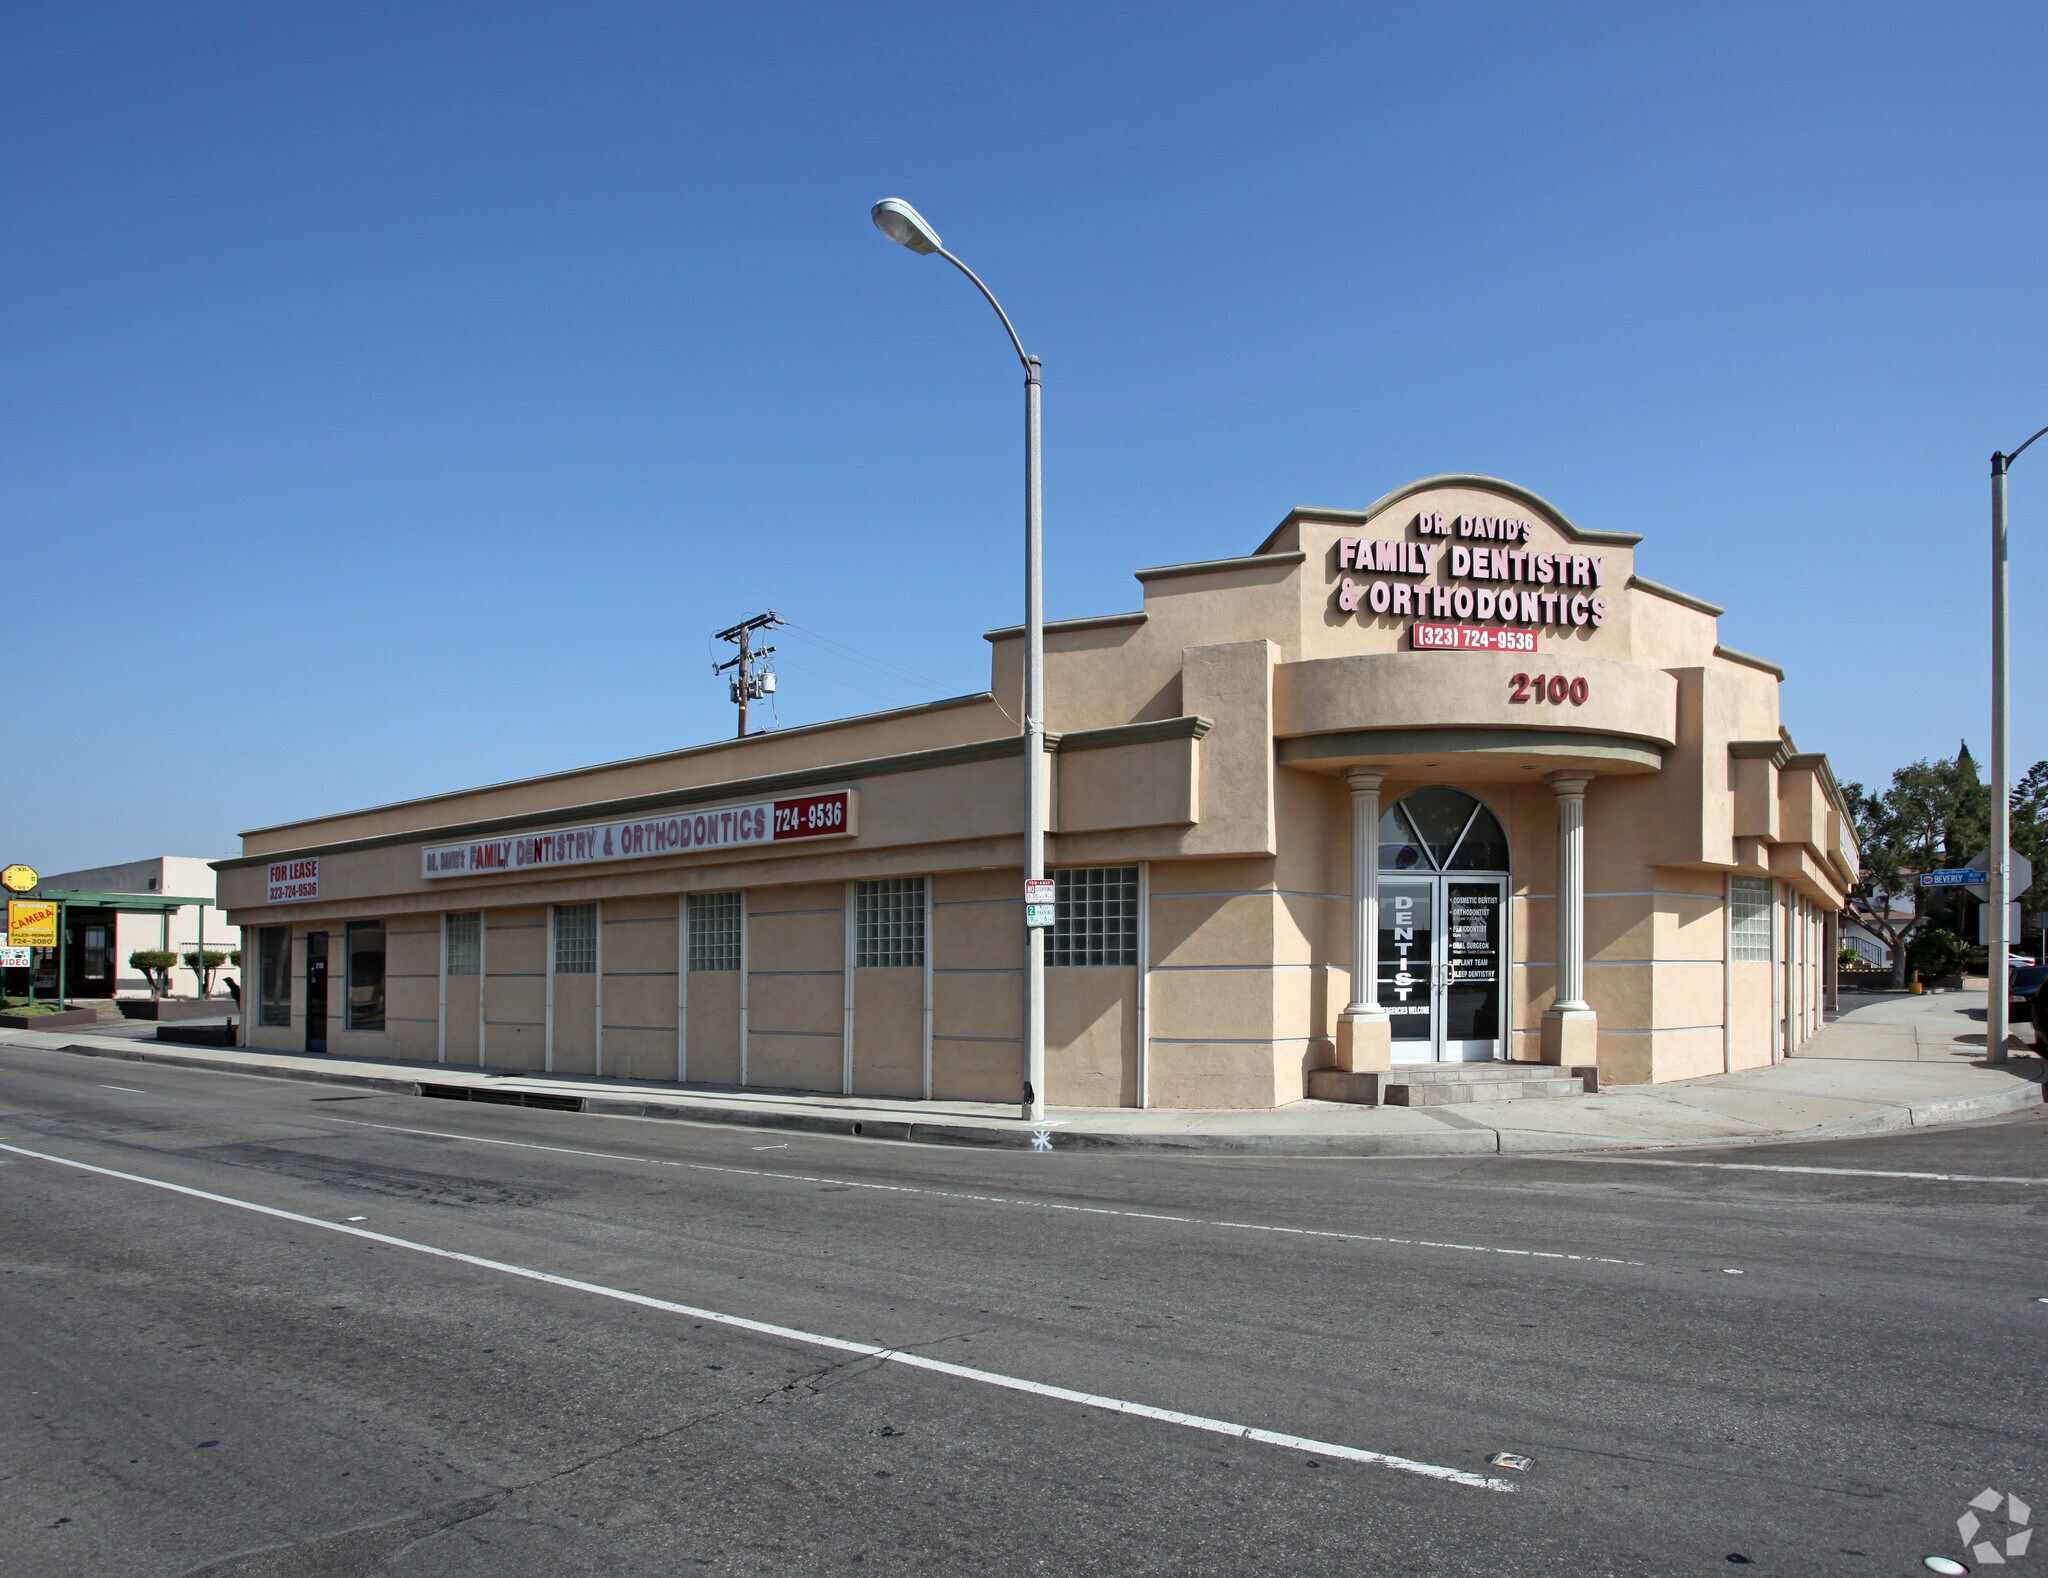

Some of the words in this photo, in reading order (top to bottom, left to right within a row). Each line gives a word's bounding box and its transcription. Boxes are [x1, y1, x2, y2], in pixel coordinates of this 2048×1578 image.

[1418, 511, 1451, 535] DR.
[1459, 514, 1534, 543] DAVID'S
[1338, 537, 1438, 575] FAMILY
[1451, 545, 1608, 588] DENTISTRY
[1338, 577, 1359, 613] &
[1369, 580, 1609, 628] ORTHODONTICS
[1418, 625, 1459, 647] (323)
[1463, 629, 1535, 651] 724-9536
[1511, 672, 1590, 704] 2100
[426, 853, 439, 872] DR.
[469, 841, 512, 871] FAMILY
[516, 829, 597, 866] DENTISTRY
[602, 827, 615, 856] &
[621, 807, 766, 855] ORTHODONTICS
[775, 801, 843, 833] 724-9536
[270, 866, 288, 882] FOR
[290, 861, 317, 880] LEASE
[1934, 875, 1962, 884] BEVERLY
[270, 882, 317, 900] 323-724-9536
[1453, 896, 1477, 904] COSMETIC
[1478, 896, 1498, 904] DENTIST
[11, 908, 54, 930] CAMERA
[1453, 908, 1490, 916] ORTHODONTIST
[1452, 925, 1487, 933] PERIODONTIST
[1394, 896, 1413, 1001] DENTIST
[1452, 941, 1466, 950] ORAL
[1467, 942, 1490, 950] SURGEON
[1452, 958, 1474, 966] IMPLANT
[1382, 1006, 1408, 1014] ERGENCIES
[1408, 1006, 1430, 1014] WELCOME
